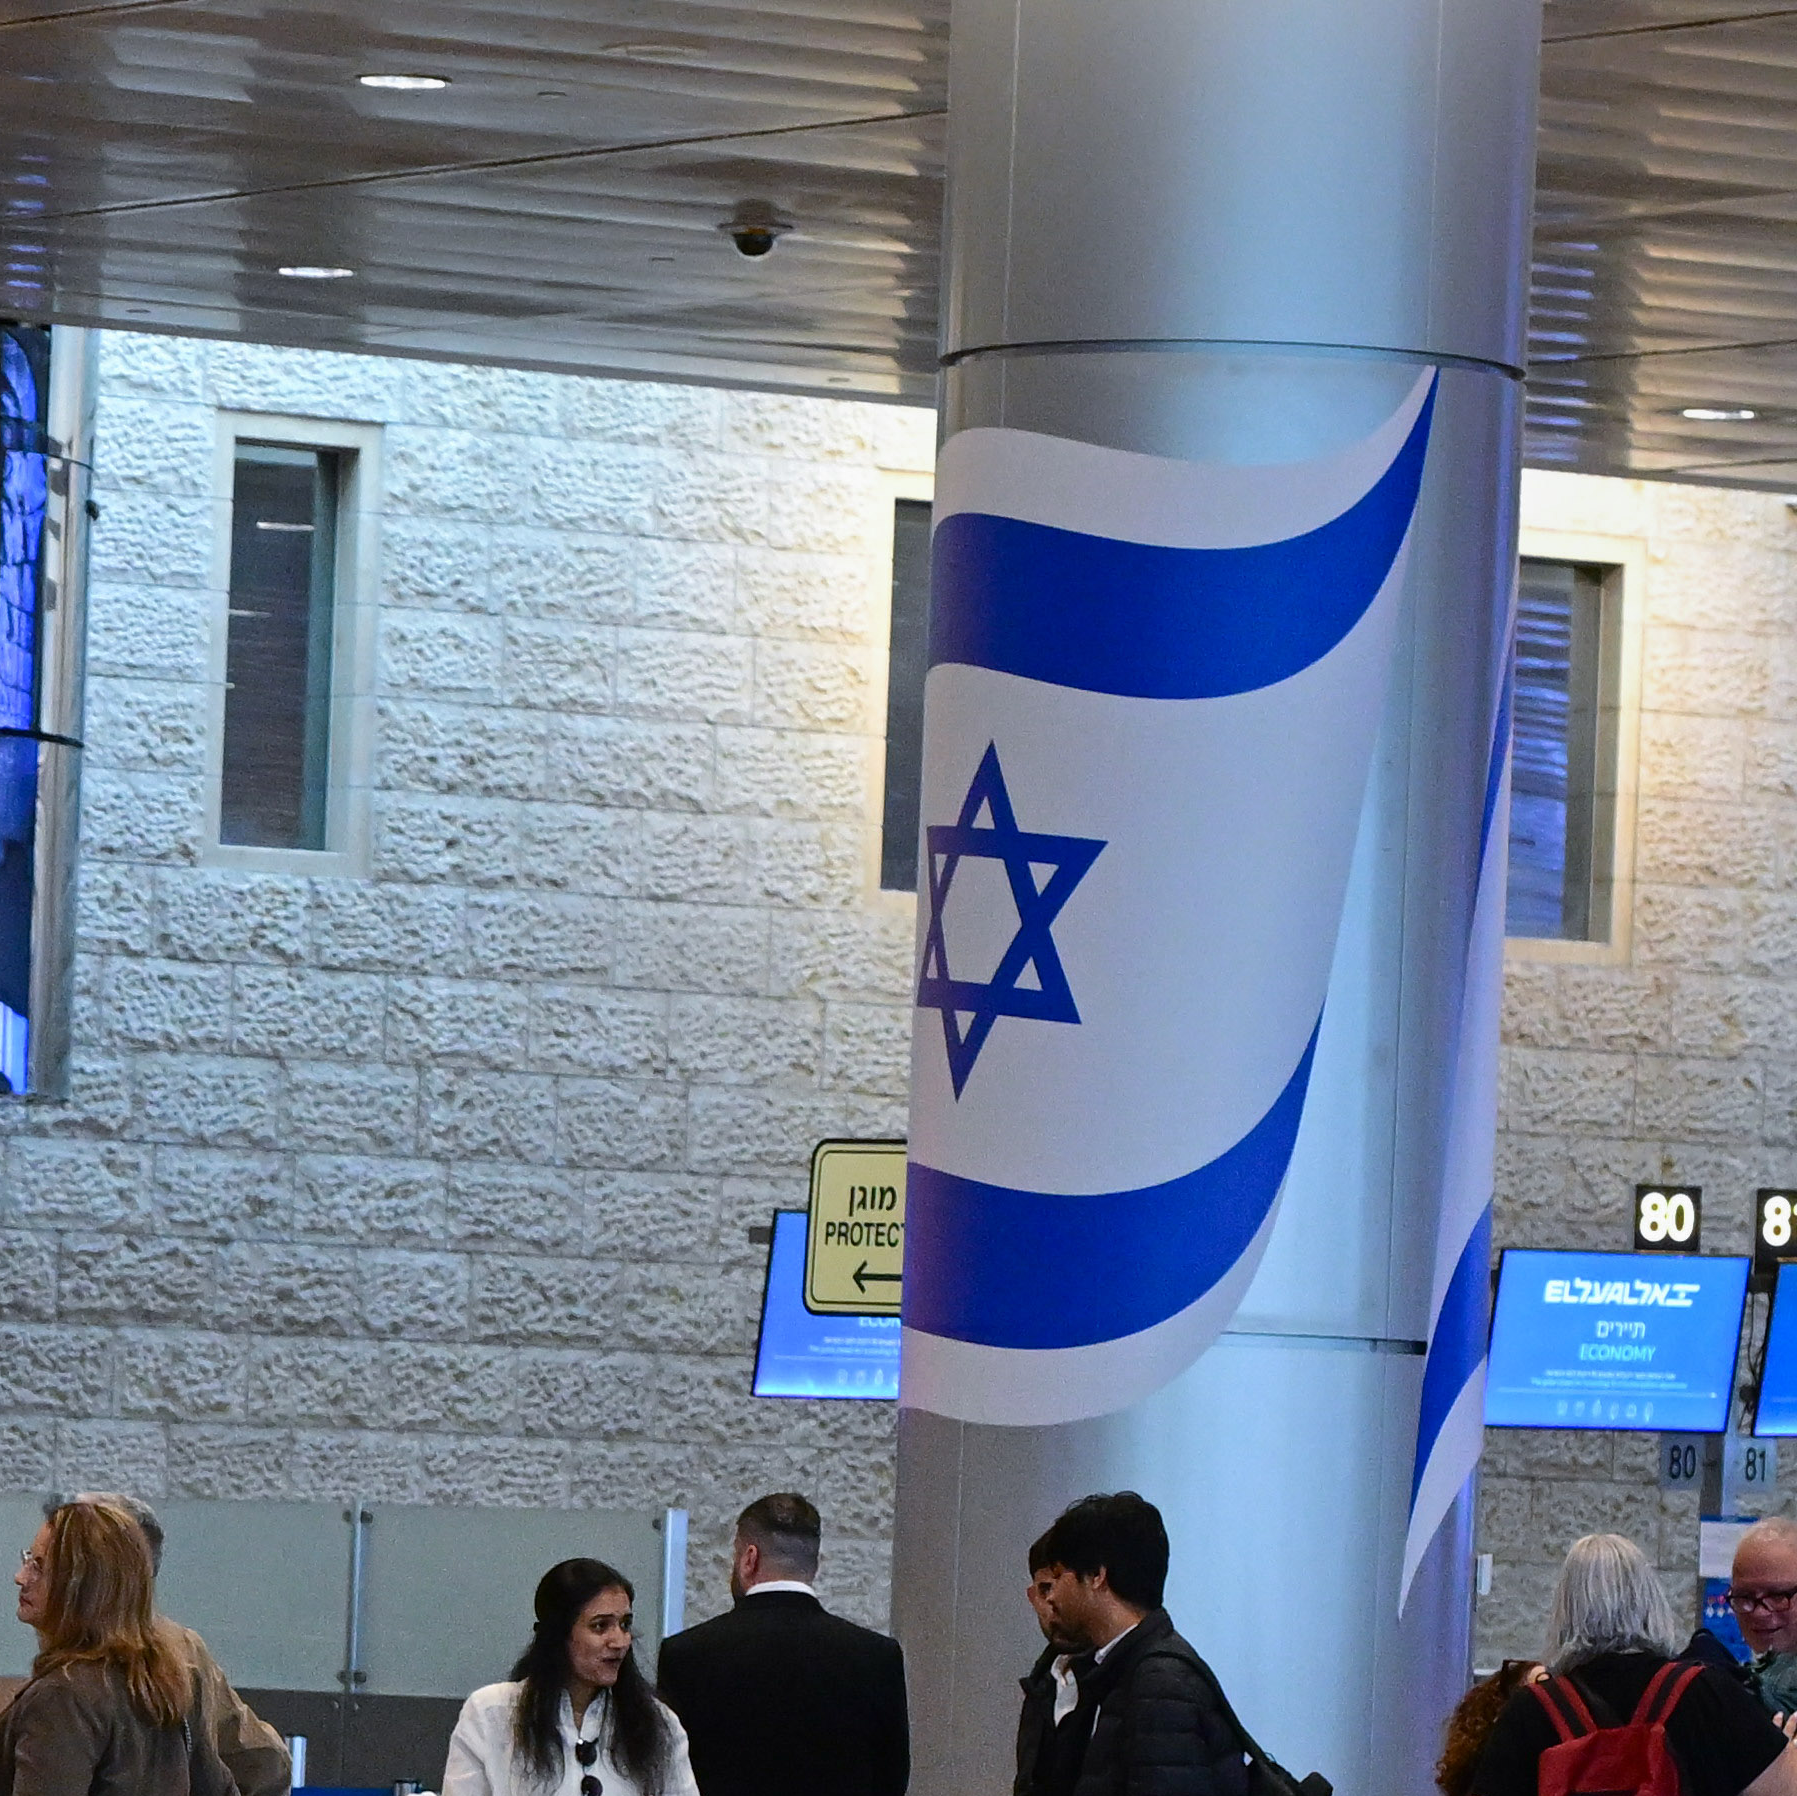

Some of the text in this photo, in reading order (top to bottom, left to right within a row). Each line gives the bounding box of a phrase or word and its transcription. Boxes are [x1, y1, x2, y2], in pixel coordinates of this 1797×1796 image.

[848, 1186, 898, 1217] מוגן
[1639, 1191, 1691, 1242] 80
[824, 1221, 905, 1248] PROTEC
[1762, 1195, 1797, 1247] 8
[1579, 1342, 1656, 1362] ECONOMY
[1669, 1445, 1696, 1481] 80
[1745, 1447, 1766, 1482] 81
